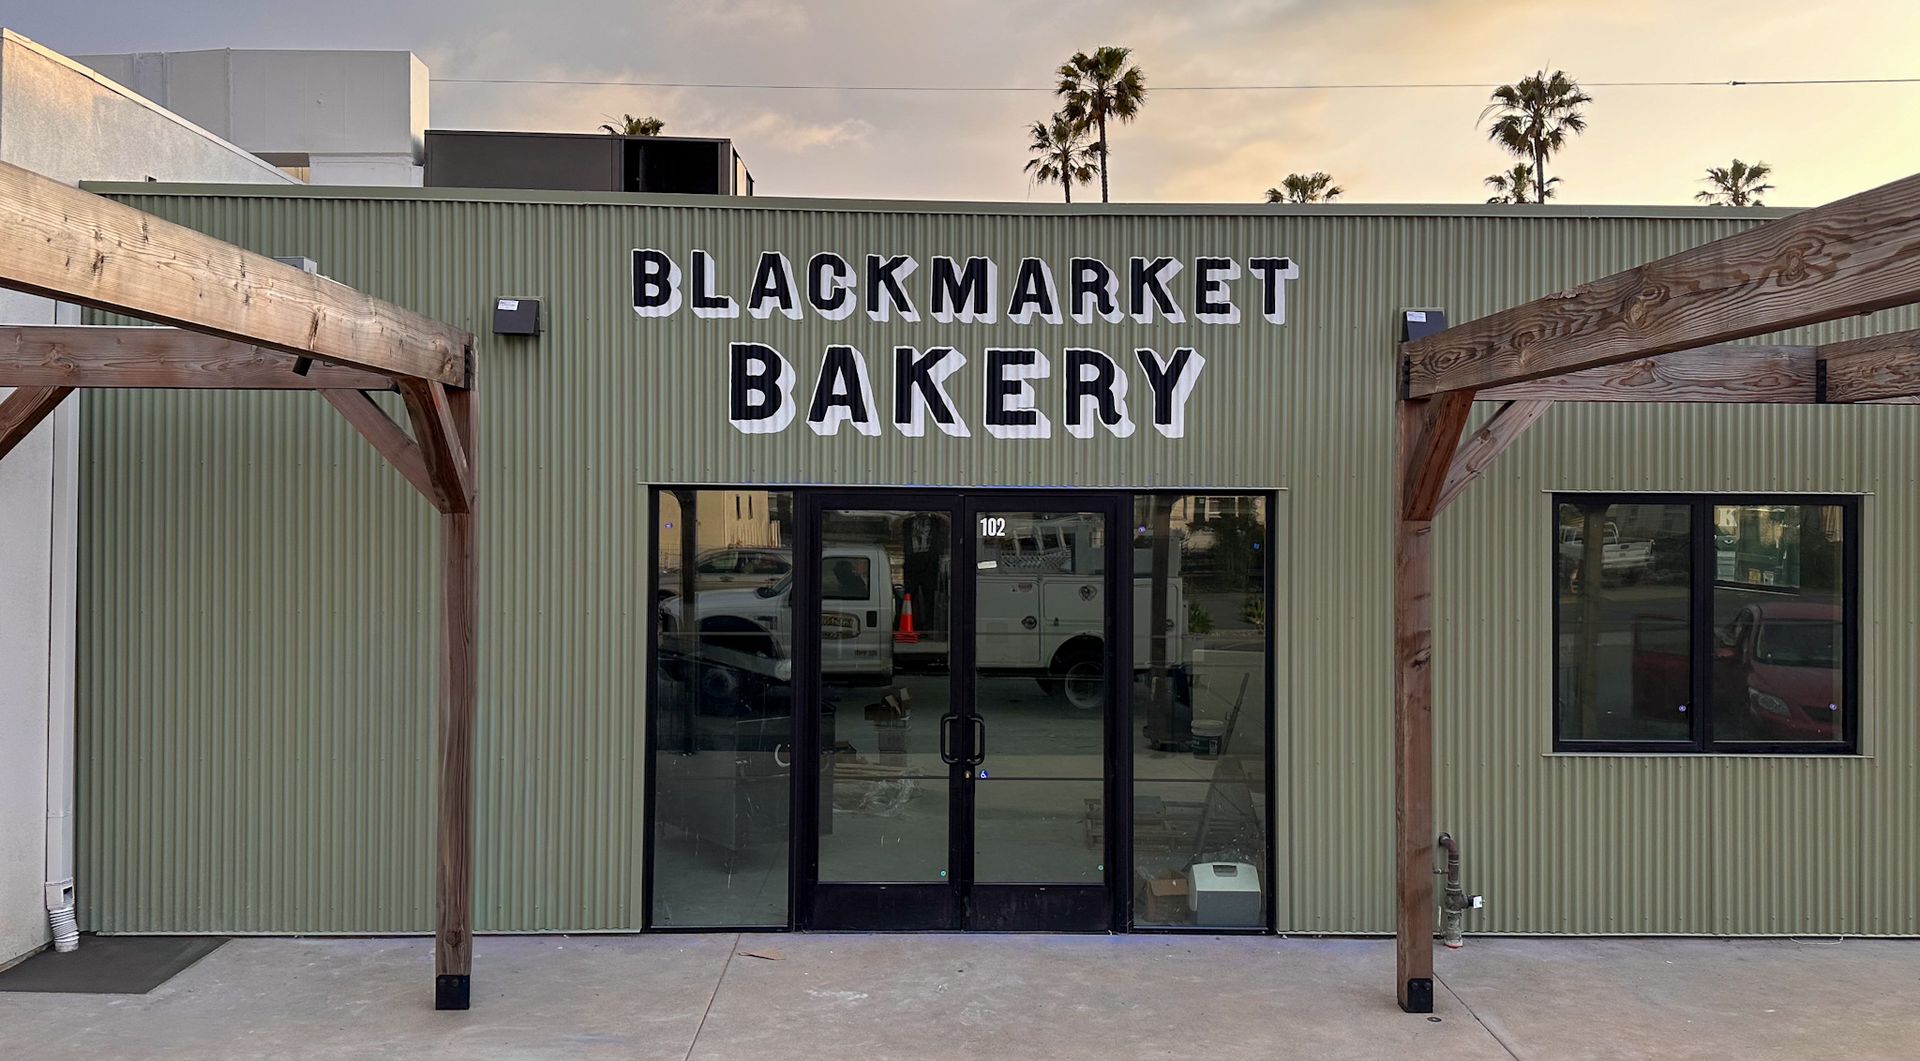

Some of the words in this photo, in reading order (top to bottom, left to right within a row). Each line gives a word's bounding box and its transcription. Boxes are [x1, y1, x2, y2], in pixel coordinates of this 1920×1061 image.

[632, 249, 1299, 325] BLACKMARKET
[728, 342, 1206, 438] BAKERY
[980, 517, 1006, 537] 102
